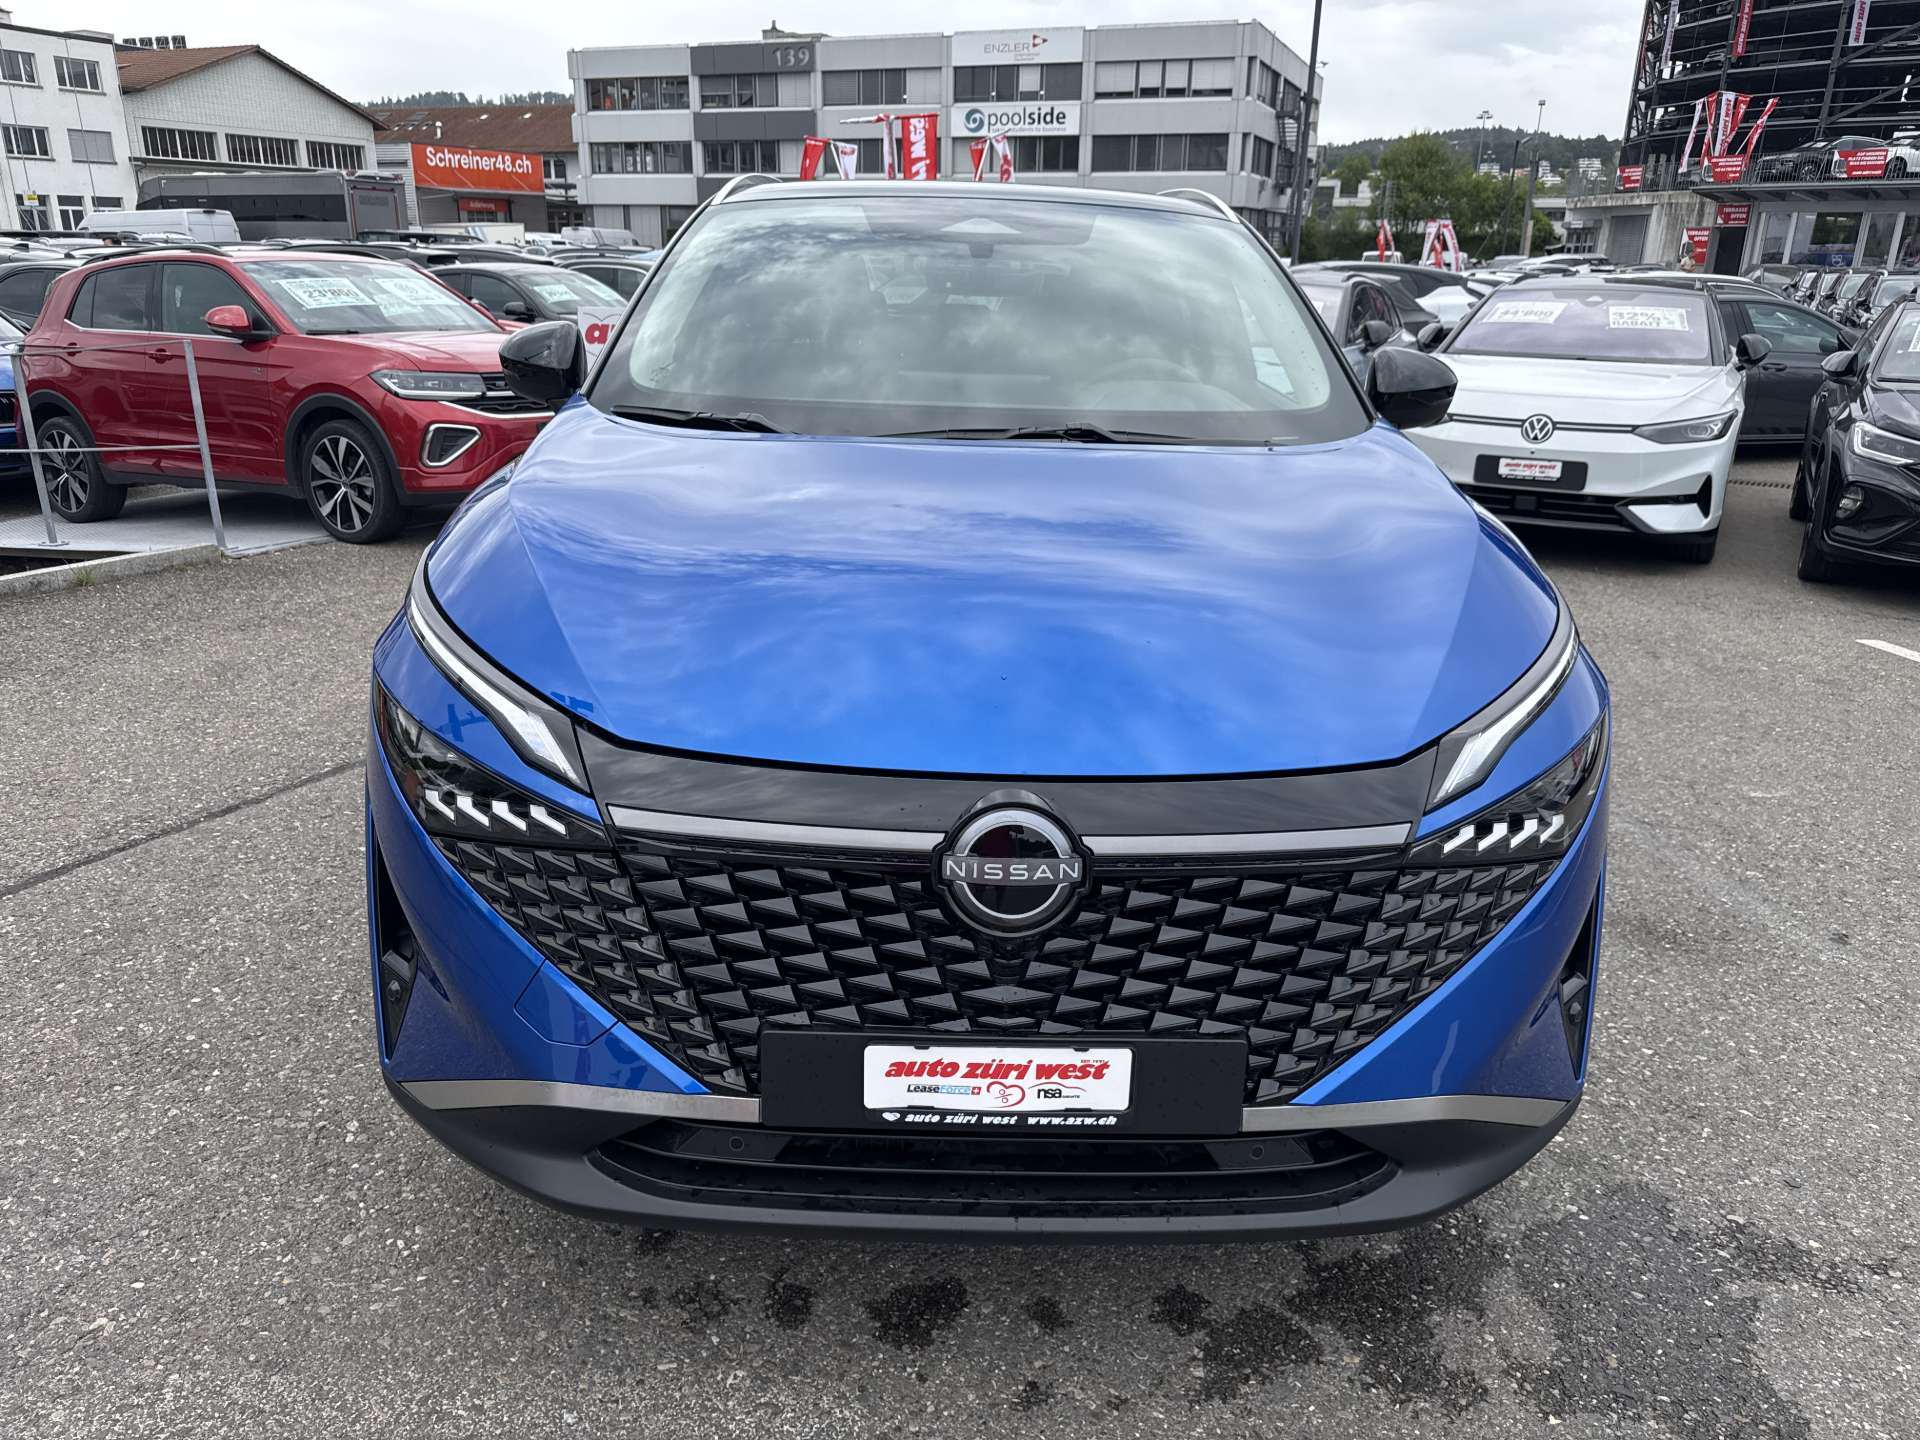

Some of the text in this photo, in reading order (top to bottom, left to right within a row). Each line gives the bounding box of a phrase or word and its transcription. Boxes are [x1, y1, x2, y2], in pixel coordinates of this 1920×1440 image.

[773, 48, 810, 66] 139
[984, 42, 1030, 54] ENZLER
[988, 106, 1066, 133] poolside
[426, 146, 532, 174] Schreiner48.ch
[946, 860, 1078, 880] NISSAN
[885, 1058, 1111, 1080] auto züri west
[1037, 1088, 1062, 1099] nsa
[905, 1112, 1117, 1126] auto züri west www.azw.ch
